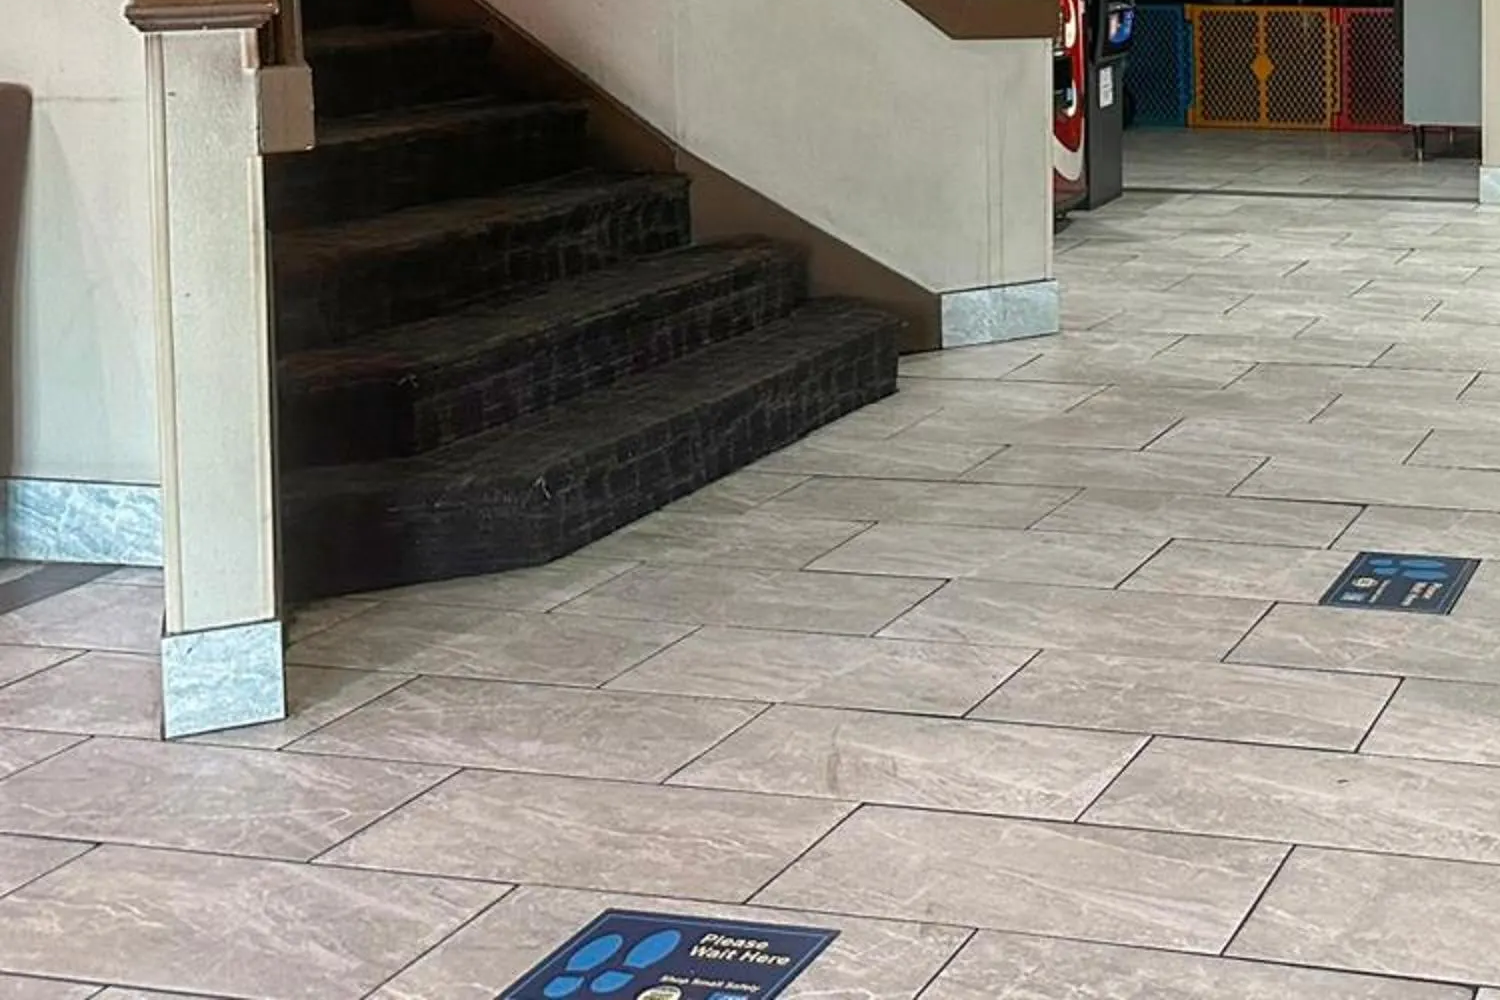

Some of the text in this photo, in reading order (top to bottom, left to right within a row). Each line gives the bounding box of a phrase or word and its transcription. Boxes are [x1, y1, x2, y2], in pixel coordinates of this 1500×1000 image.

[699, 932, 769, 950] Please
[689, 945, 792, 966] Wait Here
